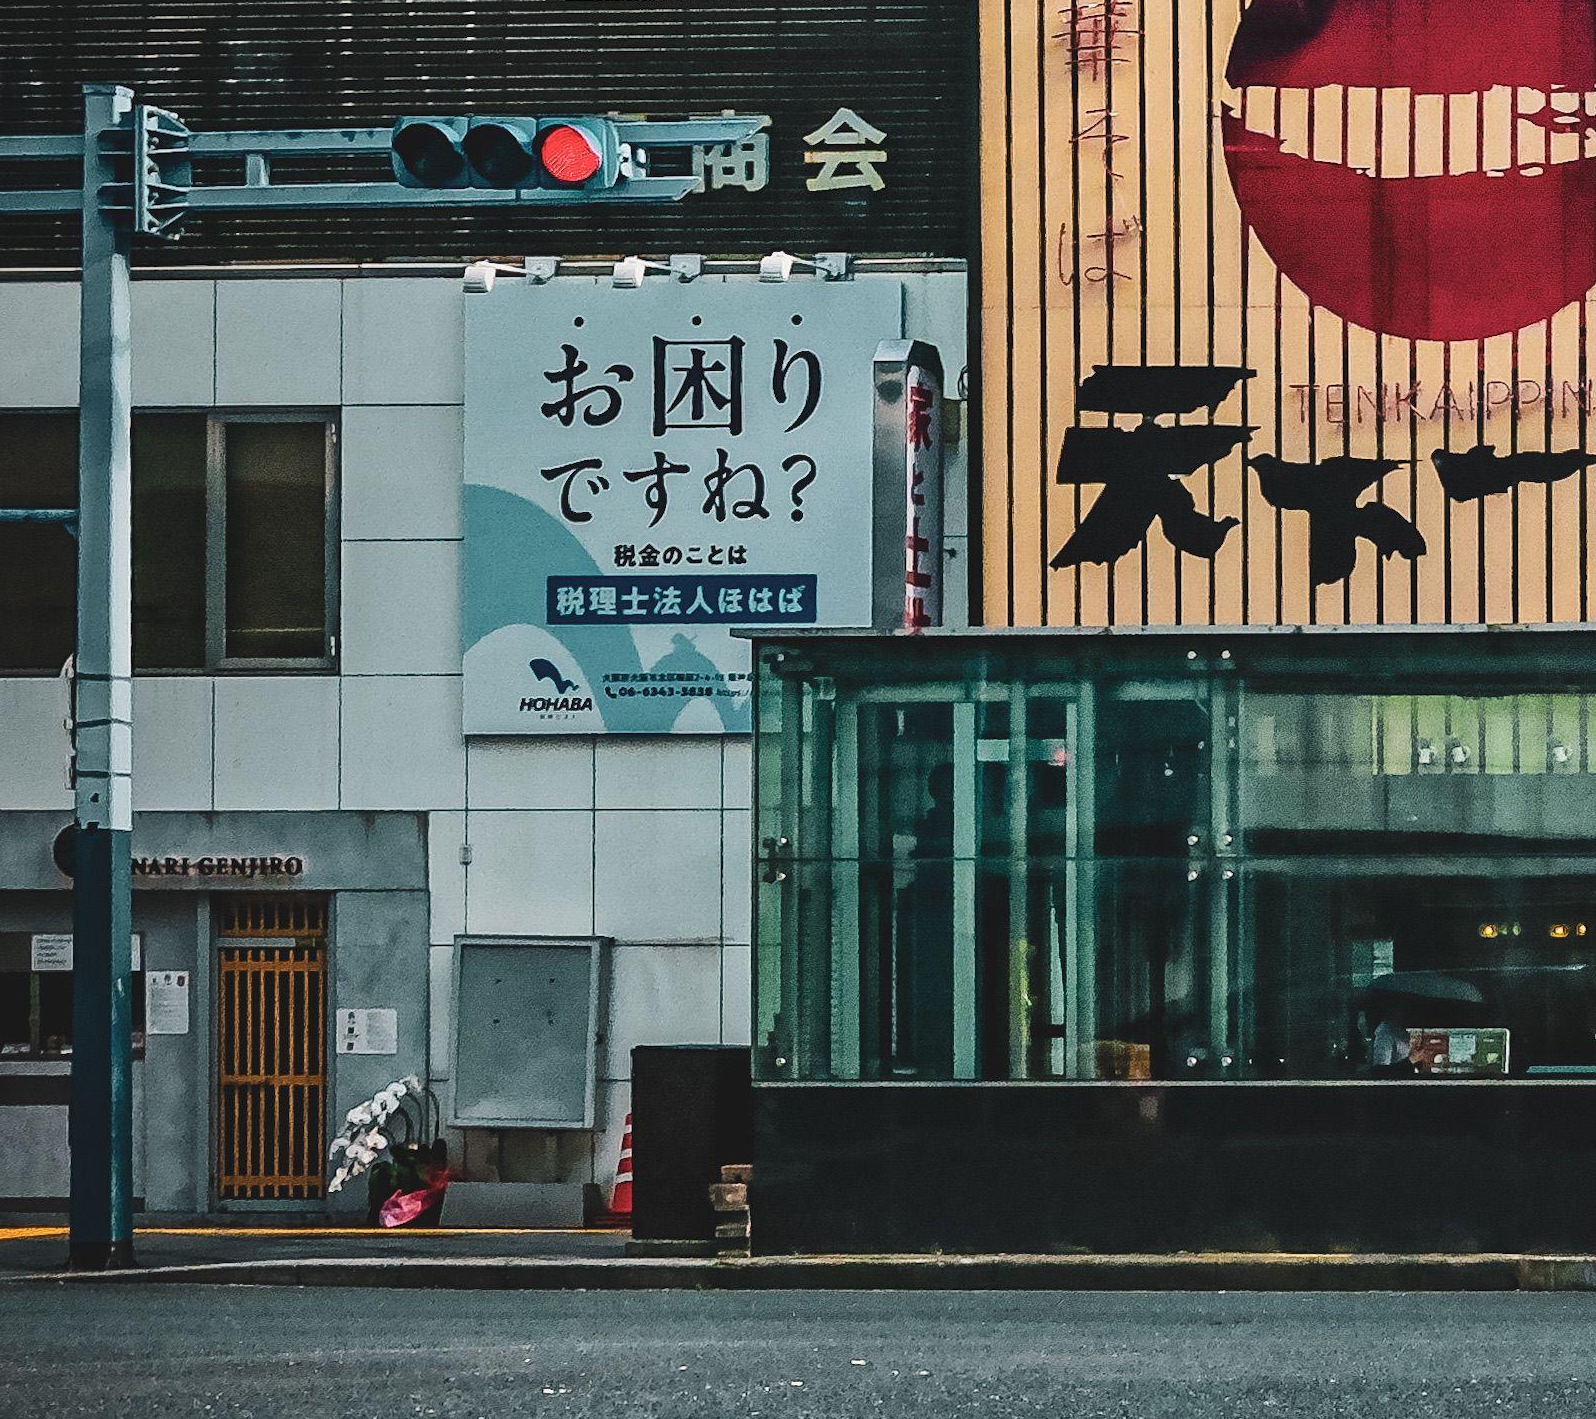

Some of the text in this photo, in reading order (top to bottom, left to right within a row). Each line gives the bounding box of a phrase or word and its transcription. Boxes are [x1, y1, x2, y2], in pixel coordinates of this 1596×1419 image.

[541, 331, 822, 436] お困り
[541, 450, 820, 527] ですね?
[613, 543, 748, 568] 税金のことは
[555, 585, 805, 617] 税理士法人ほはば
[519, 697, 593, 712] HOHABA
[131, 855, 304, 878] NARI GENJIRO
